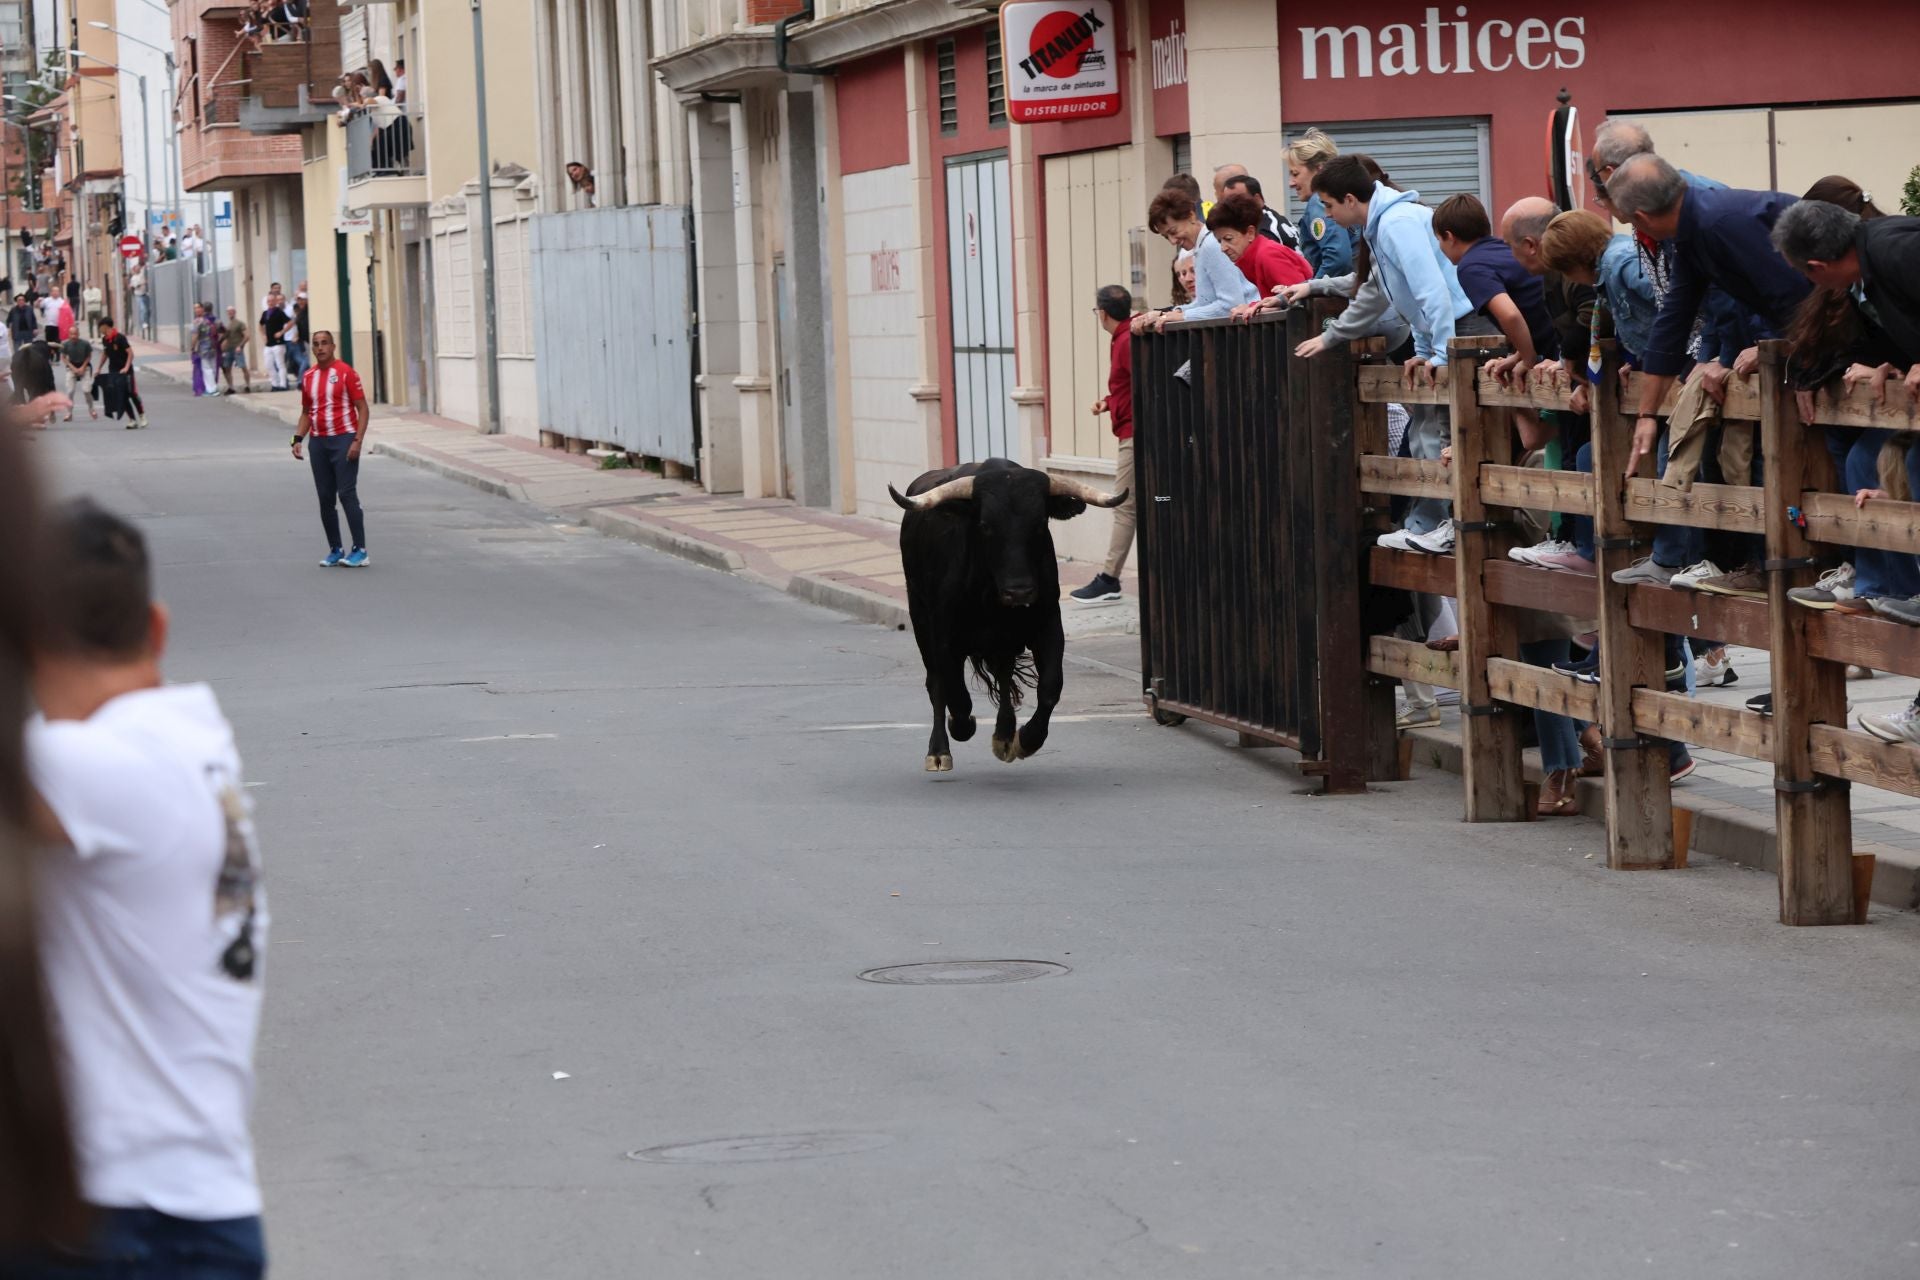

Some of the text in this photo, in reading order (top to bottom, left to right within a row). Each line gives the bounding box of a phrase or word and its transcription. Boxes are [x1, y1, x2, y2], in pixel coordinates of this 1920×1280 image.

[1019, 8, 1104, 80] TITANLUX
[1298, 5, 1586, 80] matices
[1023, 80, 1106, 93] la marca de pinturas
[1024, 101, 1107, 116] DISTRIBUIDOR
